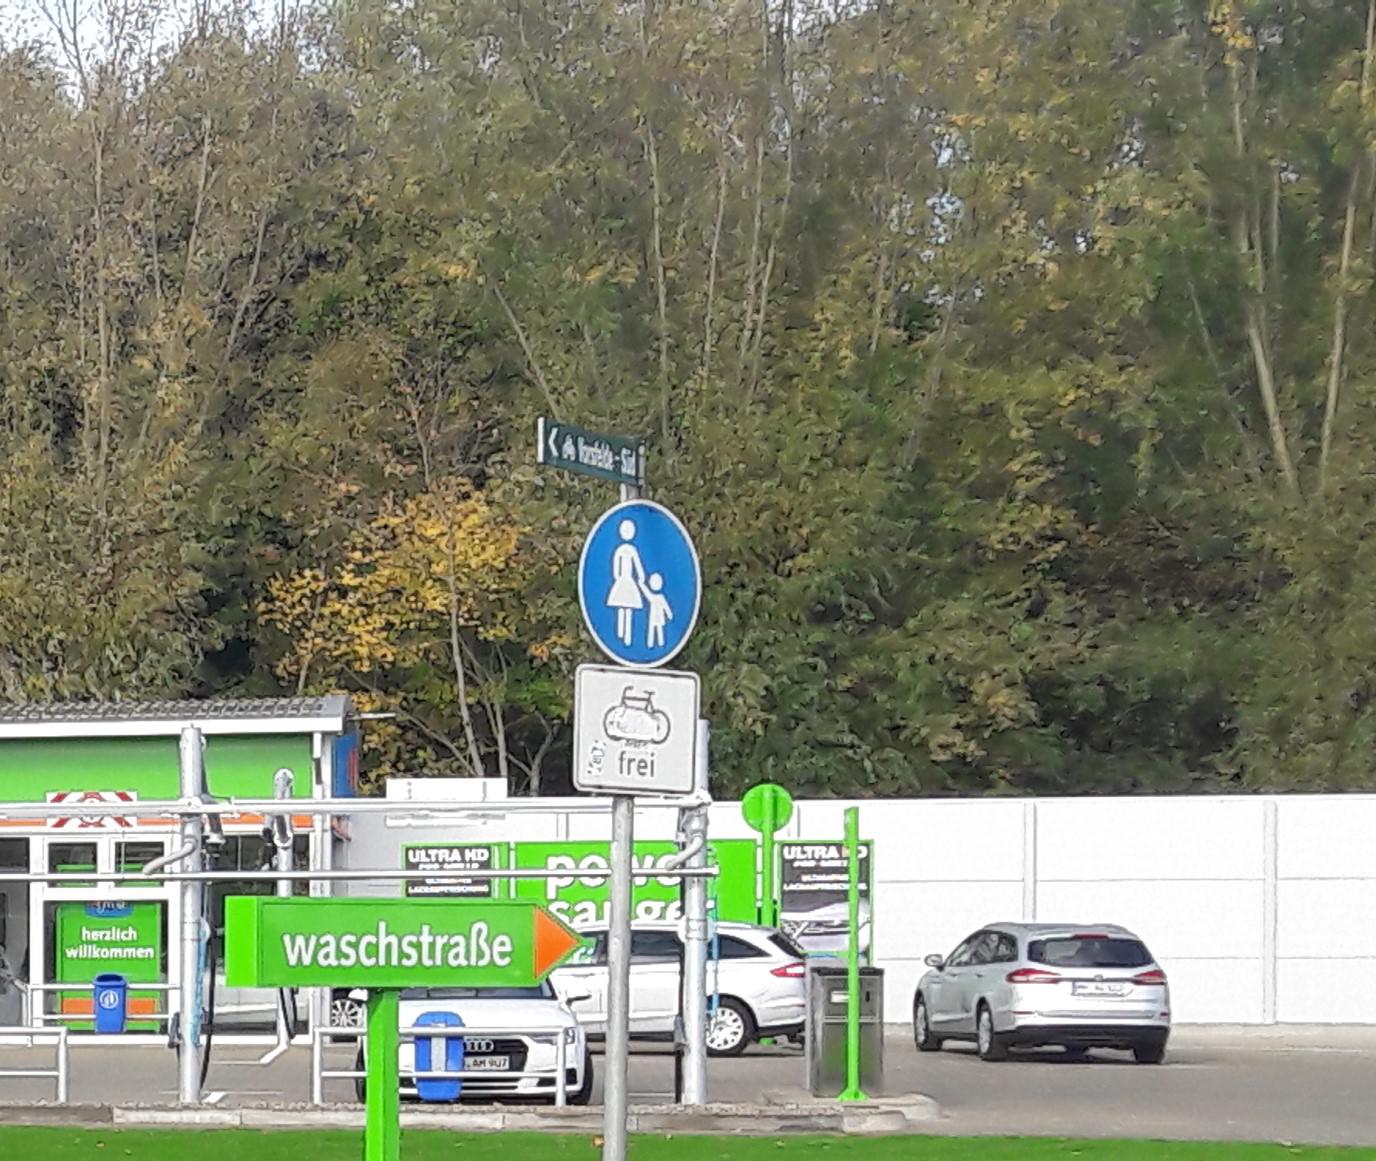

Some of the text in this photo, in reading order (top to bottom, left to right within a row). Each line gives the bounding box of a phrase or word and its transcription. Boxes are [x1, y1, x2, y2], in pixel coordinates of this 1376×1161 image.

[618, 750, 655, 777] frei
[408, 848, 490, 862] ULTRA HD
[783, 845, 840, 860] ULTRA
[81, 926, 138, 941] herzlich
[65, 944, 155, 959] willkommen
[282, 921, 513, 967] waschstraße
